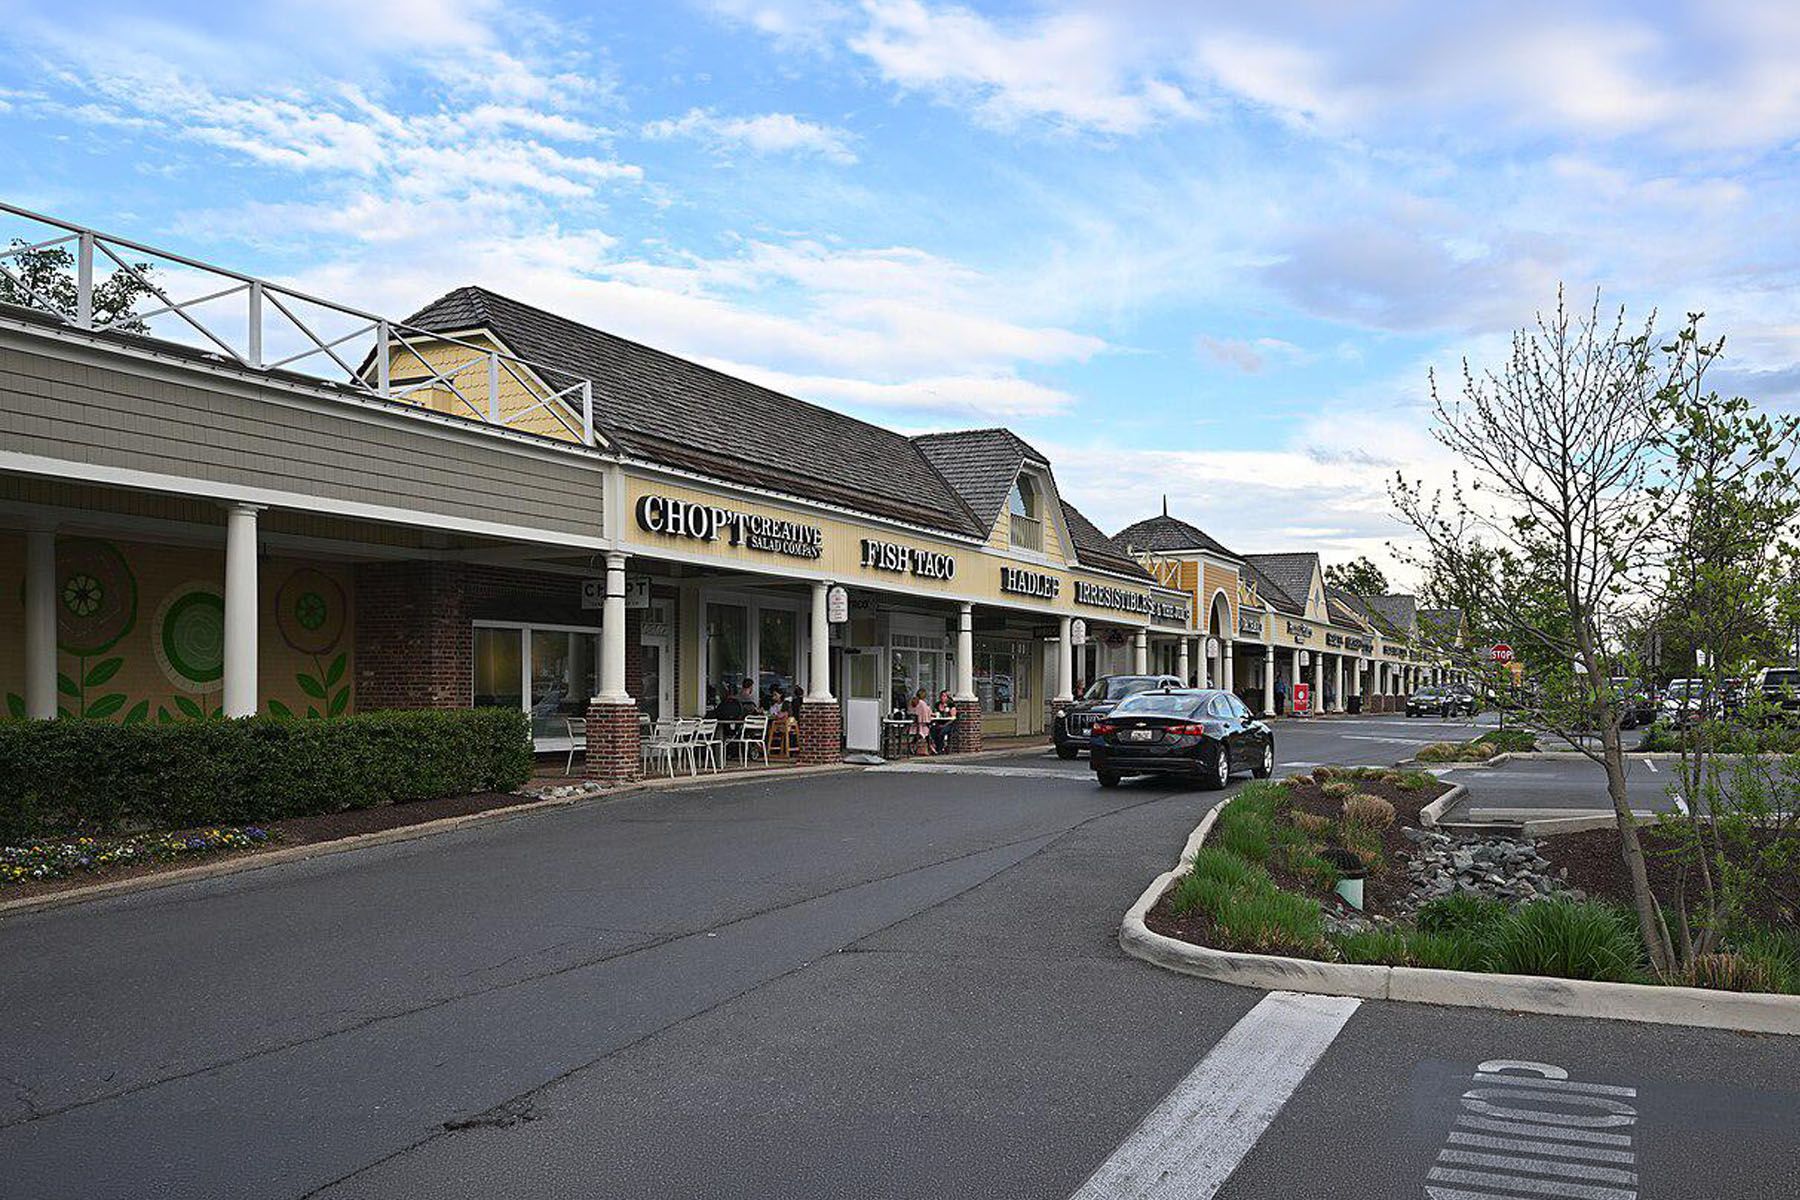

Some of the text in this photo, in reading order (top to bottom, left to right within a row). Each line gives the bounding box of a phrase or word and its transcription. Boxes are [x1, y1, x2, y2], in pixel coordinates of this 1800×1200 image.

[642, 495, 750, 546] CHOP'T
[750, 516, 823, 546] CREATIVE
[751, 536, 782, 552] SALAD
[866, 539, 956, 581] FISH TACO
[1491, 650, 1513, 660] STOP
